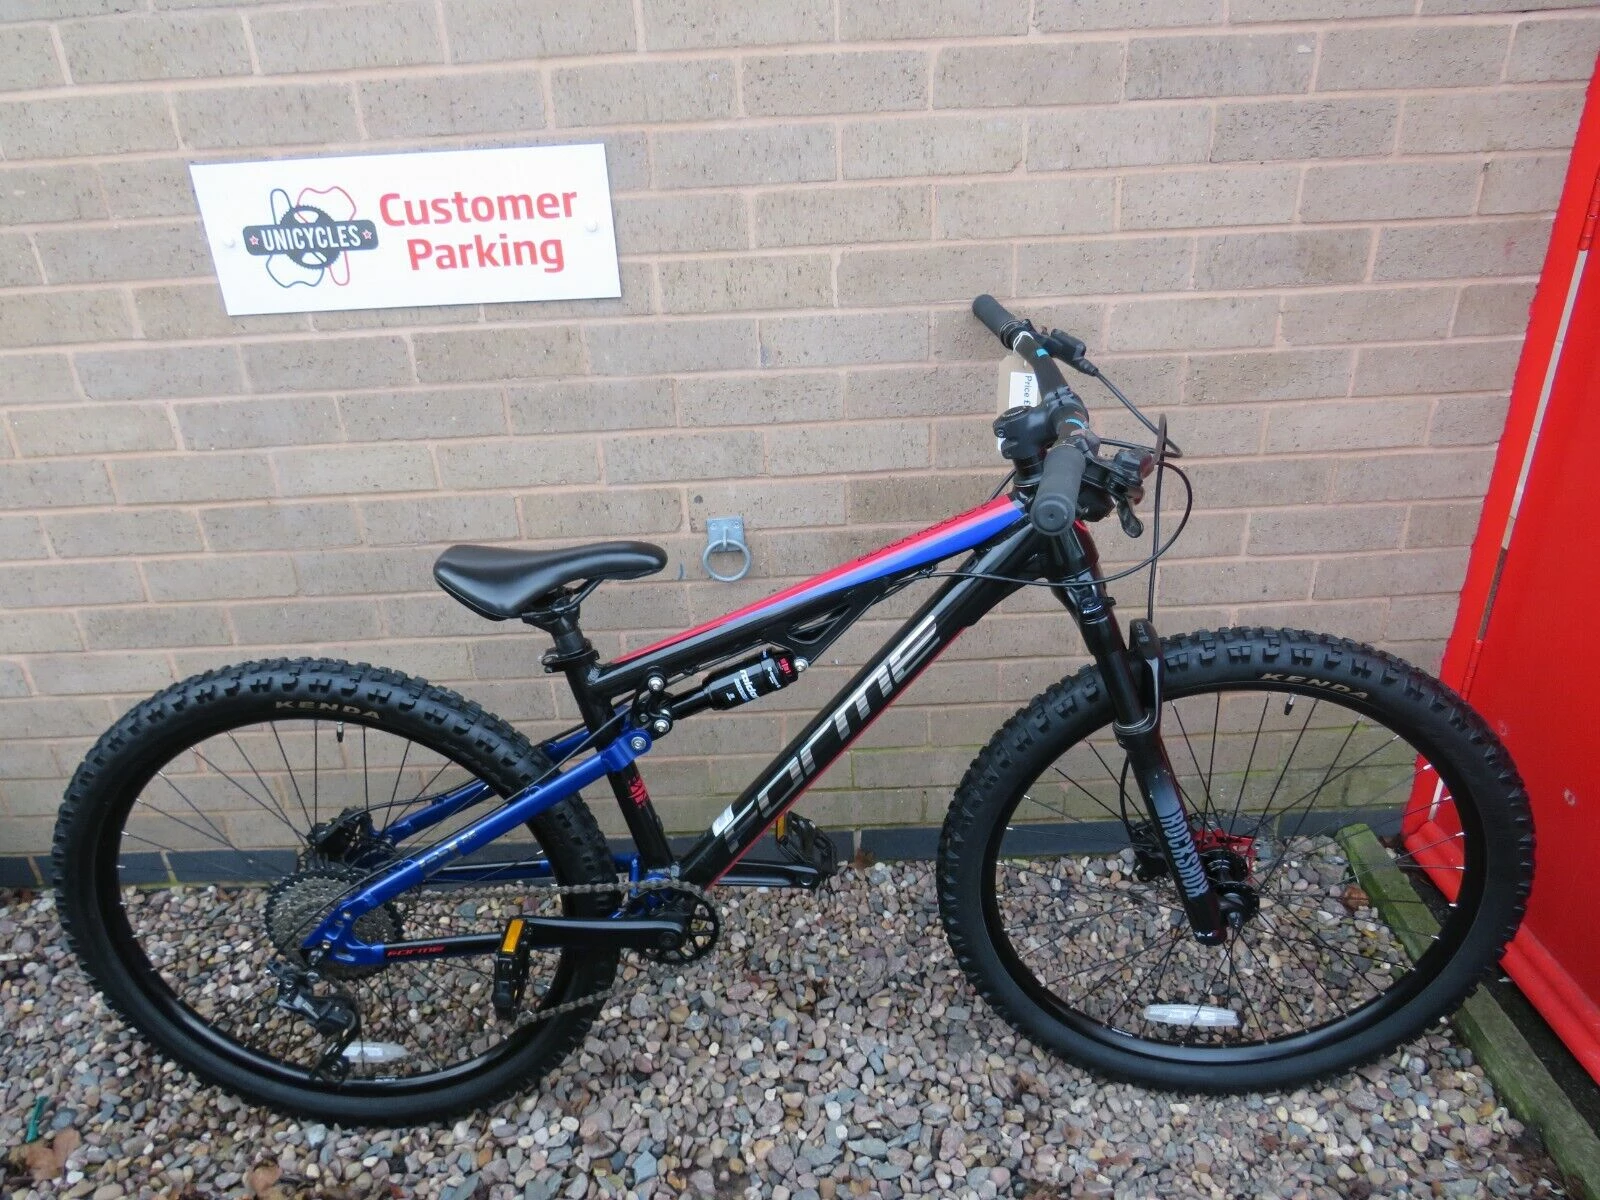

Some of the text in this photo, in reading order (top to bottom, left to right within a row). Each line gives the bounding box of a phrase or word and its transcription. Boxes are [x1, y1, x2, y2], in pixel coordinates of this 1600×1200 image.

[379, 191, 577, 227] Customer
[261, 225, 361, 252] UNICYCLES
[406, 234, 565, 273] Parking
[1023, 375, 1032, 397] Price
[1261, 673, 1368, 698] KENDA
[276, 702, 379, 719] KENDA
